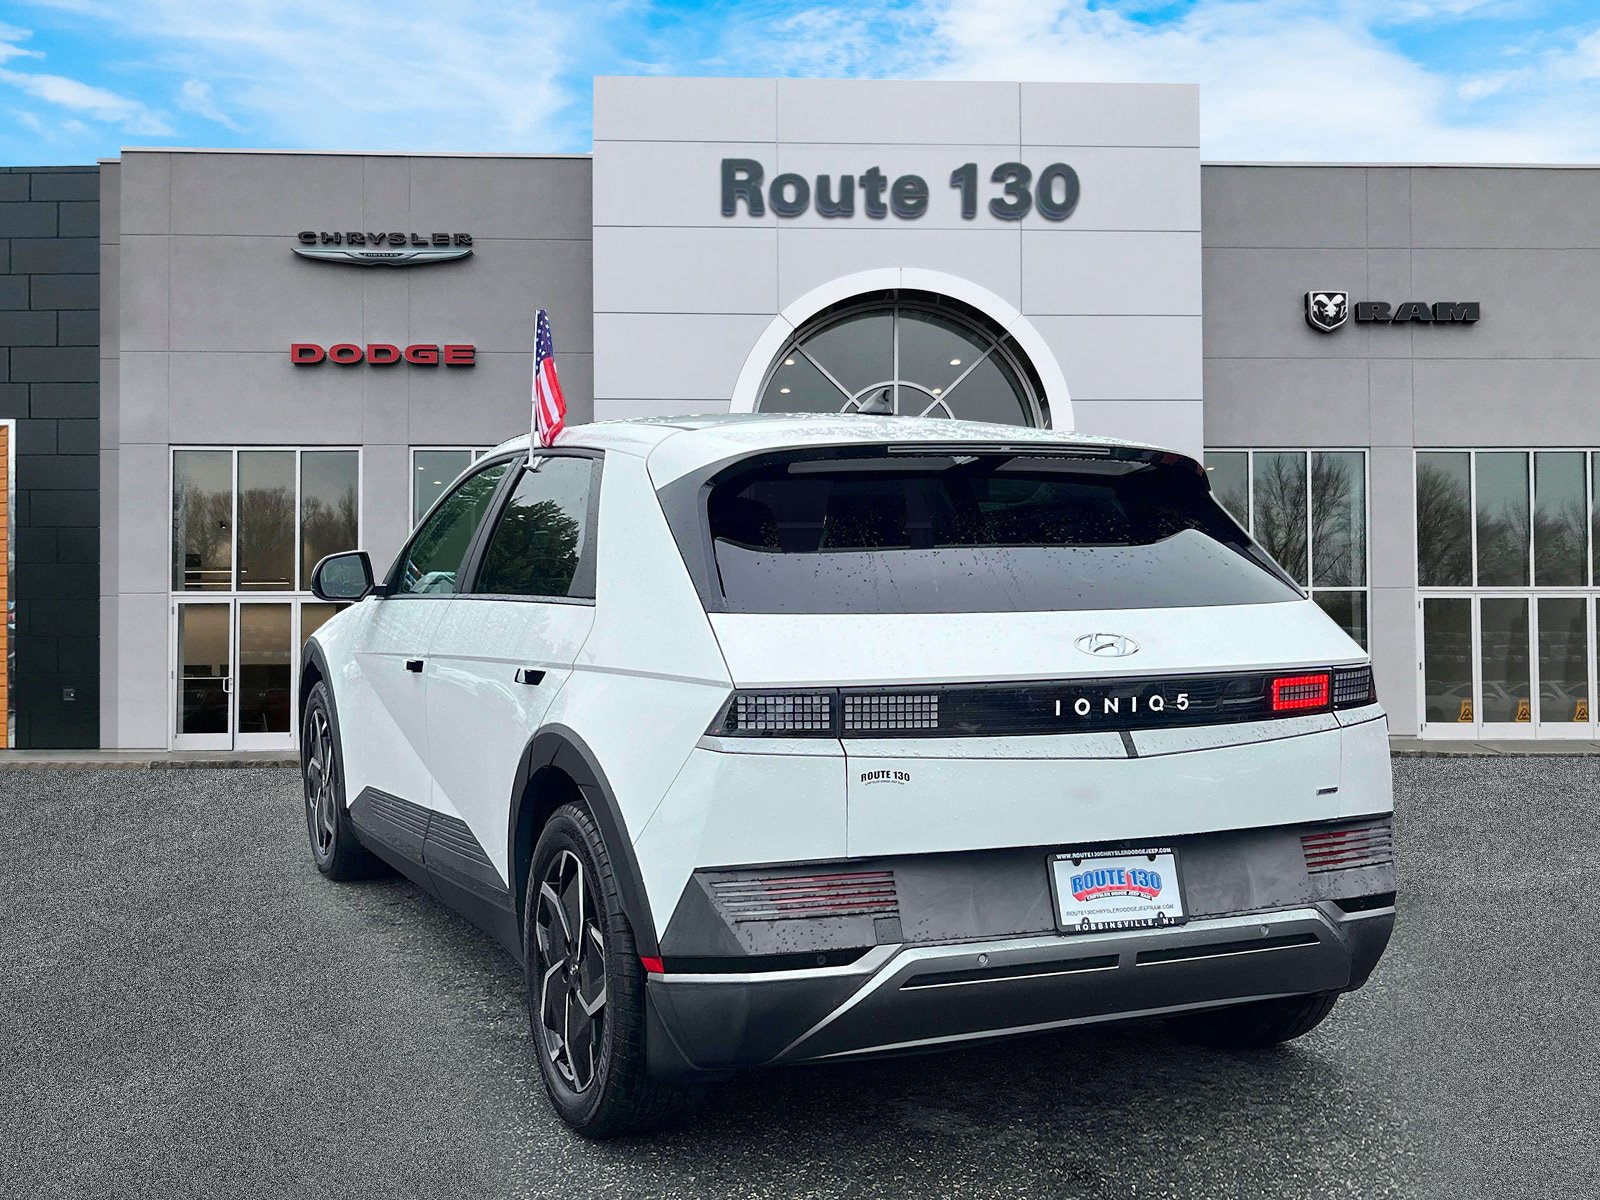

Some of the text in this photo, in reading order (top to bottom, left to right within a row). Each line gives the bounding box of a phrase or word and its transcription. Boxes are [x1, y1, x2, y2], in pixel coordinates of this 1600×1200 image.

[721, 158, 1080, 221] Route 130
[298, 231, 472, 245] CHRYSLER
[1354, 302, 1480, 323] RAM
[291, 343, 475, 366] DODGE
[861, 770, 910, 782] ROUTE 130
[1071, 867, 1162, 894] ROUTE 130
[1075, 917, 1175, 932] ROBBINSVILLE, NJ
